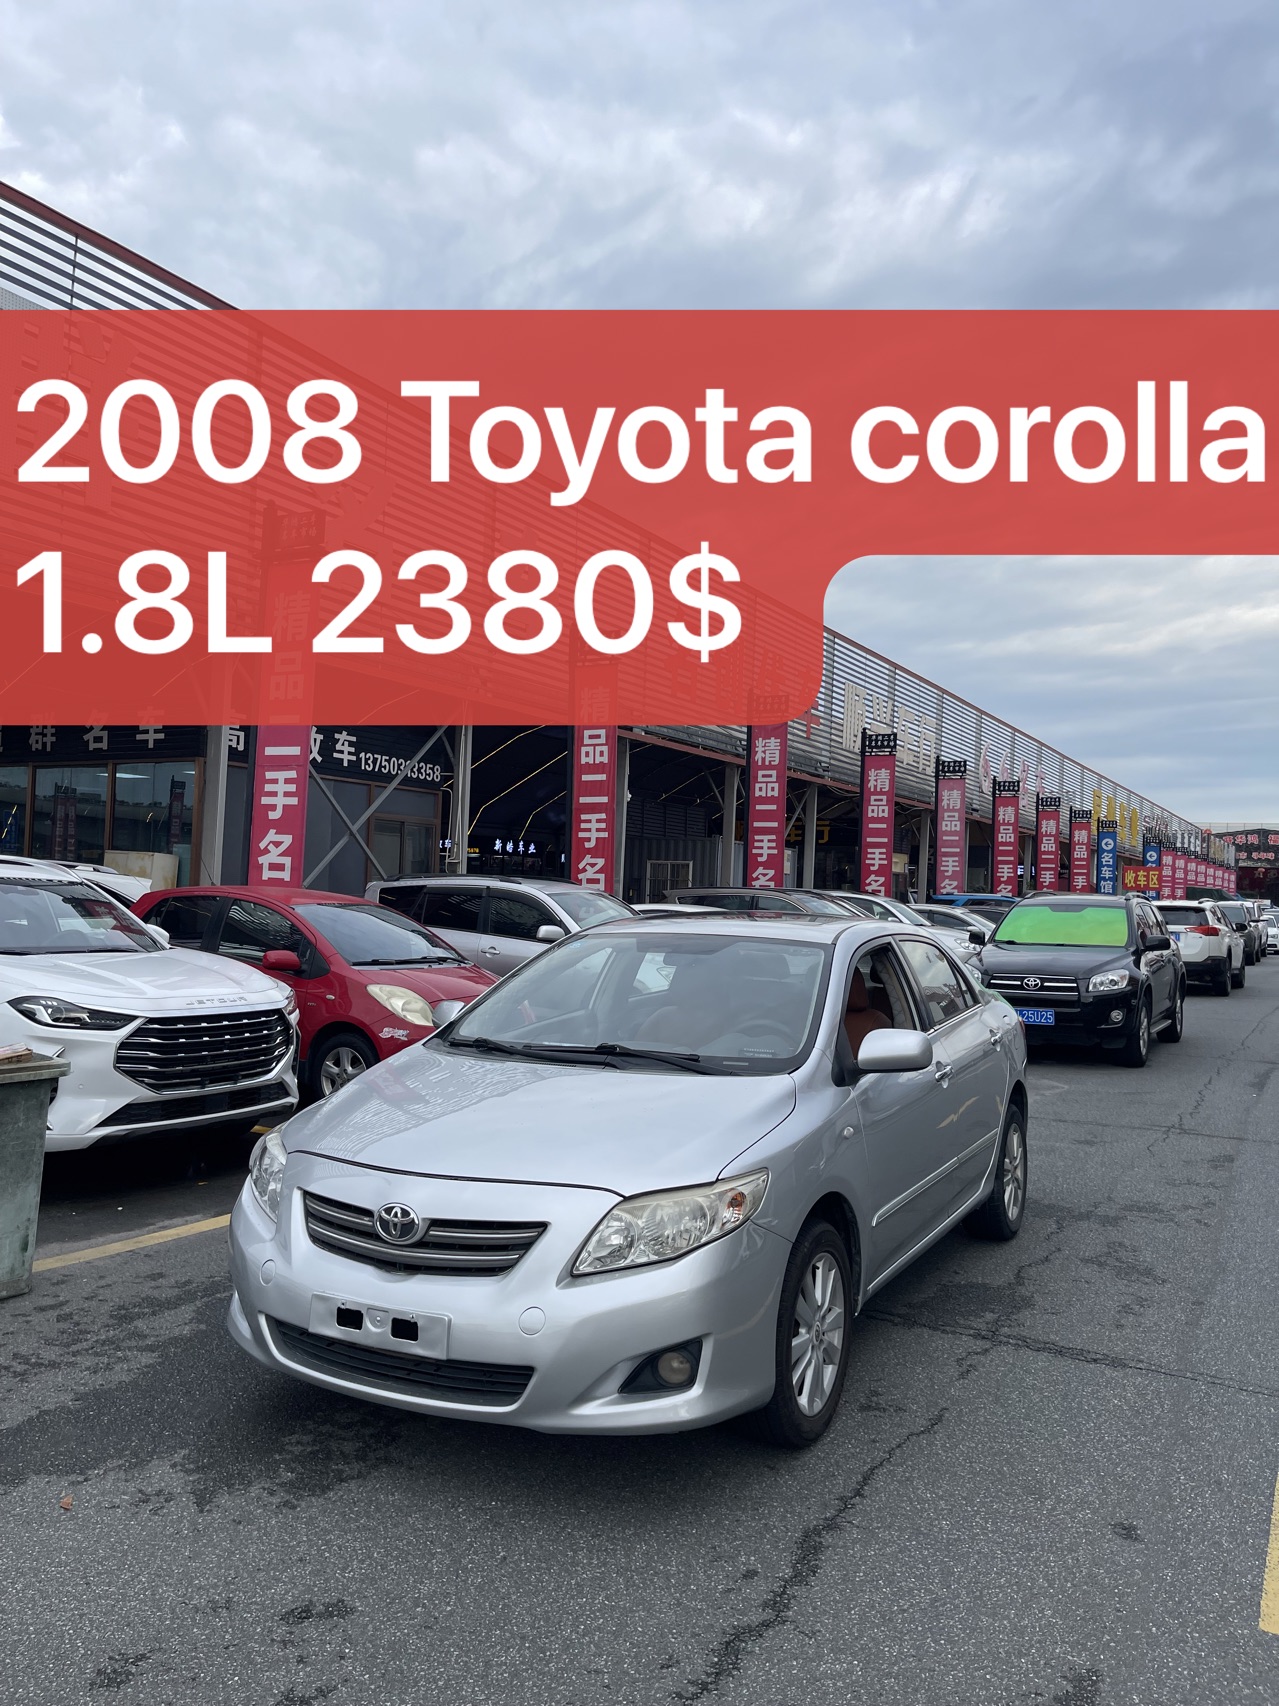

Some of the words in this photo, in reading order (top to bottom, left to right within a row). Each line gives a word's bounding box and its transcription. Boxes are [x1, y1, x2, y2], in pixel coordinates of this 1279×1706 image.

[1039, 820, 1057, 891] 精品二手
[1124, 870, 1159, 888] 收车区
[1017, 1010, 1053, 1023] 25U25
